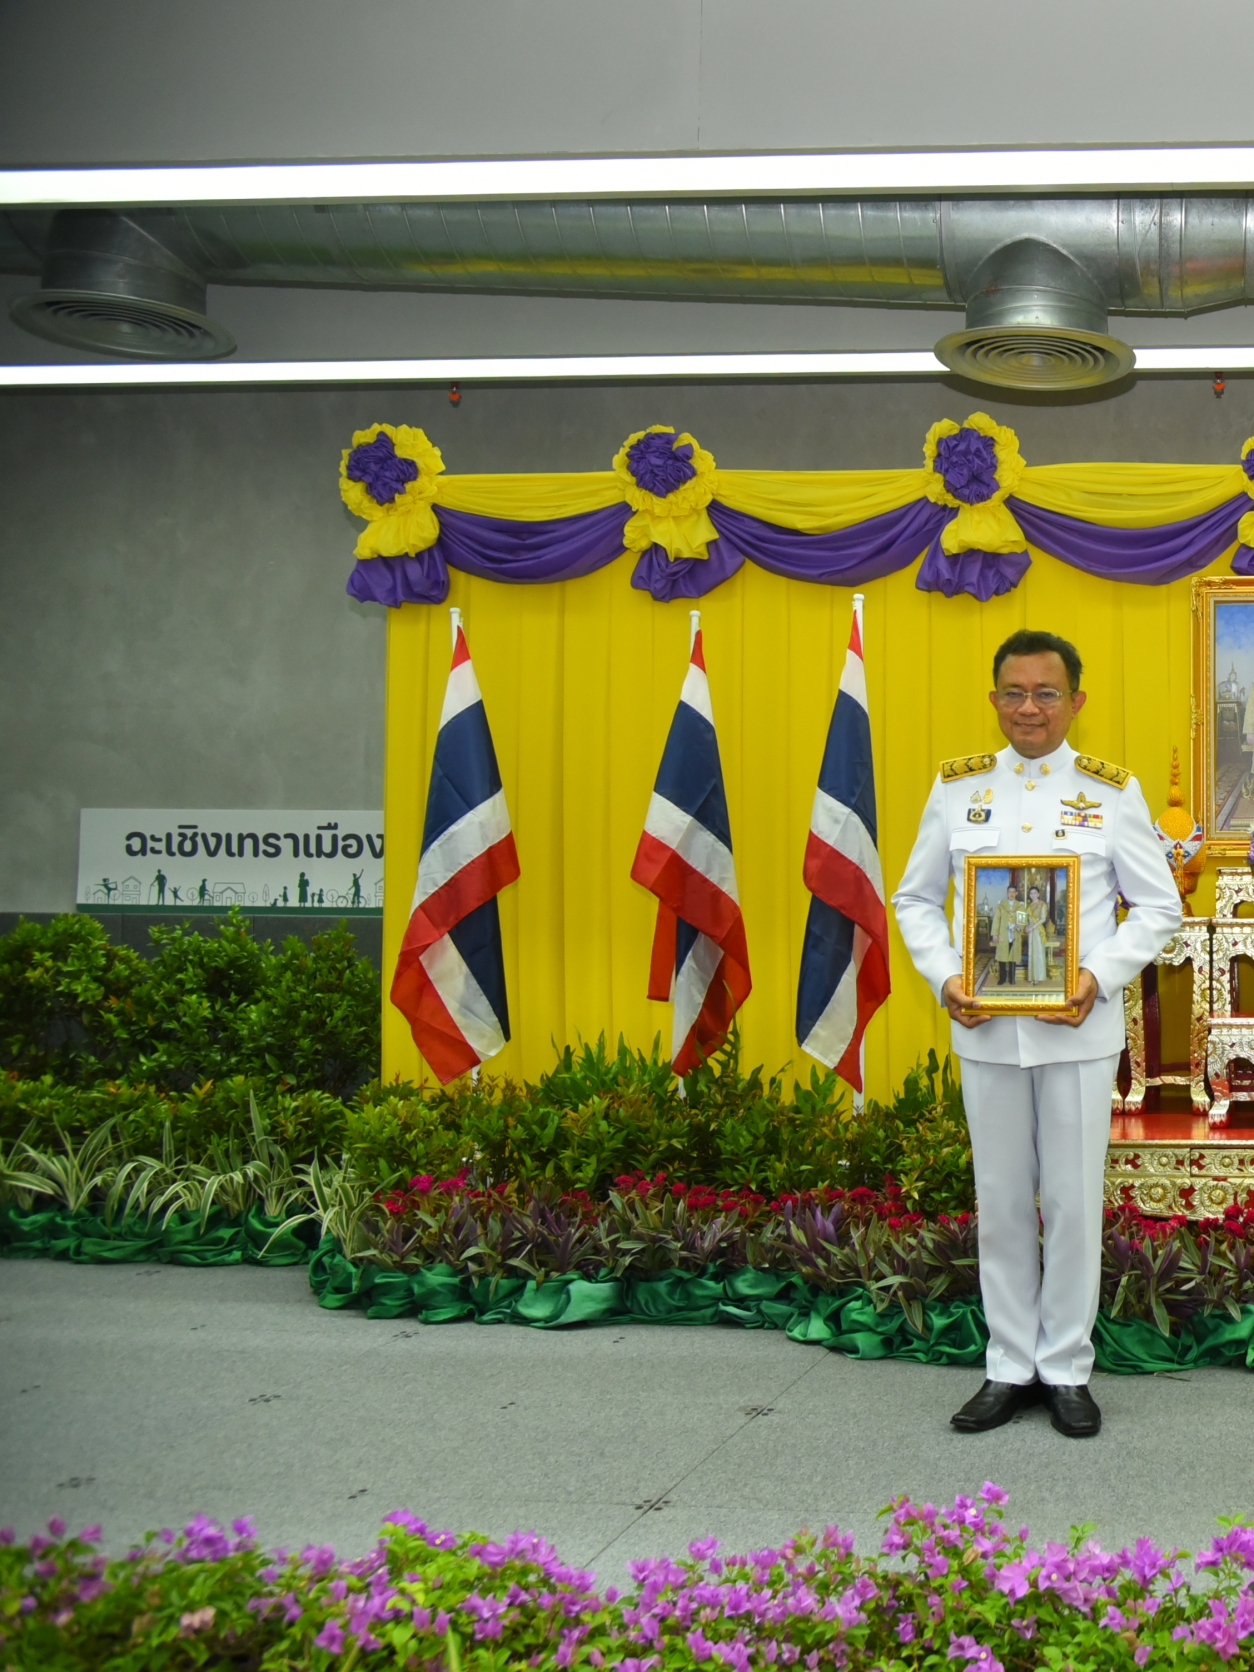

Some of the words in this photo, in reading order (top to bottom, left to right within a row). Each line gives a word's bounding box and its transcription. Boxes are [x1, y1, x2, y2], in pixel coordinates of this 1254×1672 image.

[124, 822, 385, 859] ฉะเชิงเทราเมือง
